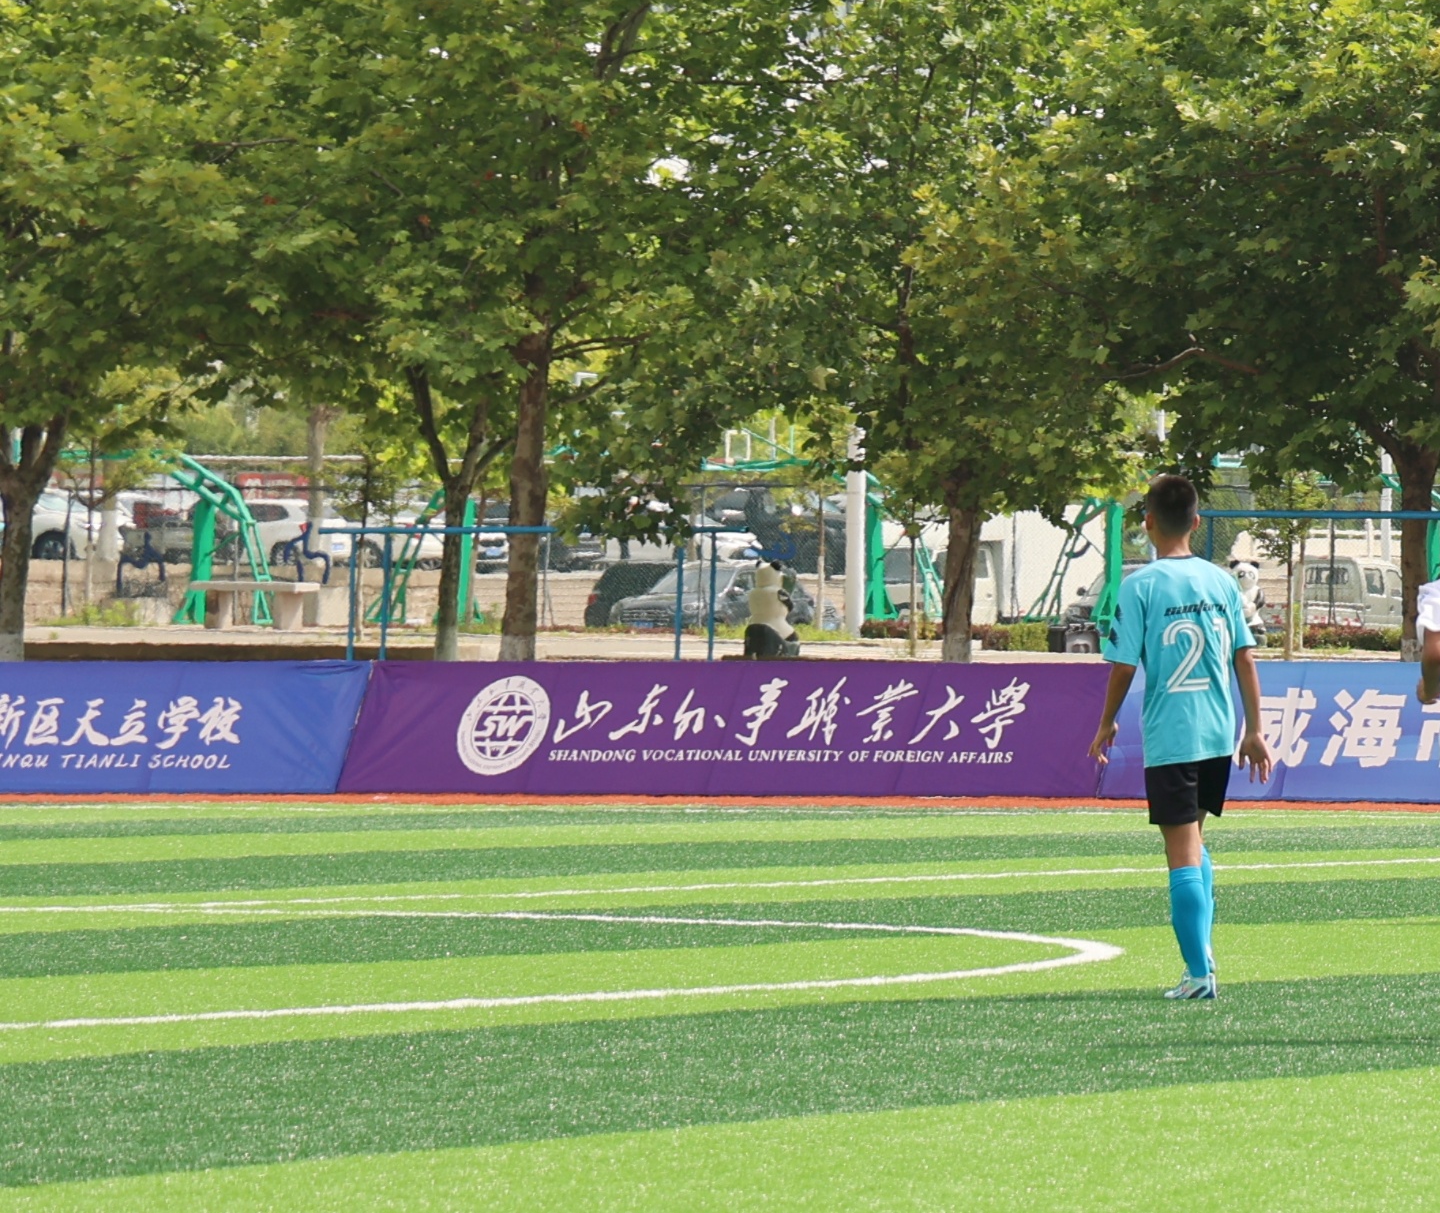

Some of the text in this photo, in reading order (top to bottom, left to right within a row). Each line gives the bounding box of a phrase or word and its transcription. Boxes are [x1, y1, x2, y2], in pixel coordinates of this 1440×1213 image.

[1162, 617, 1231, 693] 21
[61, 753, 142, 769] TIANLI
[148, 754, 231, 770] SCHOOL
[548, 749, 1014, 764] SHANDONG VOCATIONAL UNIVERSITY OF FOREIGN AFFAIRS
